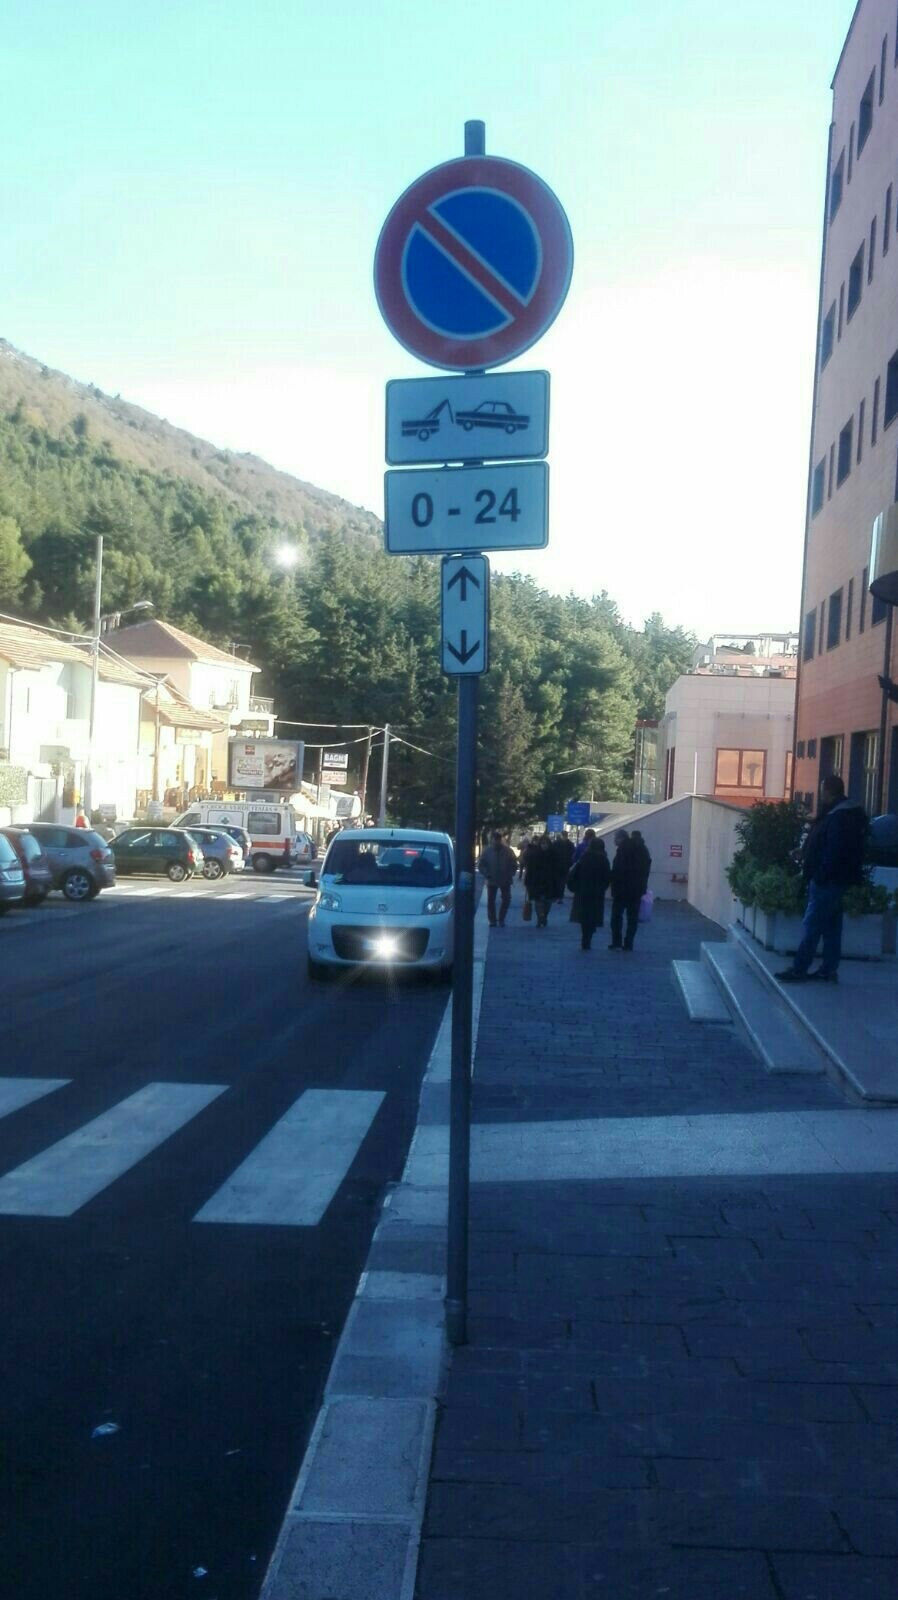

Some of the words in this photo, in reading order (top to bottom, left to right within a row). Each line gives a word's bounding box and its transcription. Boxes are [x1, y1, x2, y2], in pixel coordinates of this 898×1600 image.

[411, 492, 434, 528] 0
[447, 507, 461, 517] -
[474, 487, 521, 525] 24
